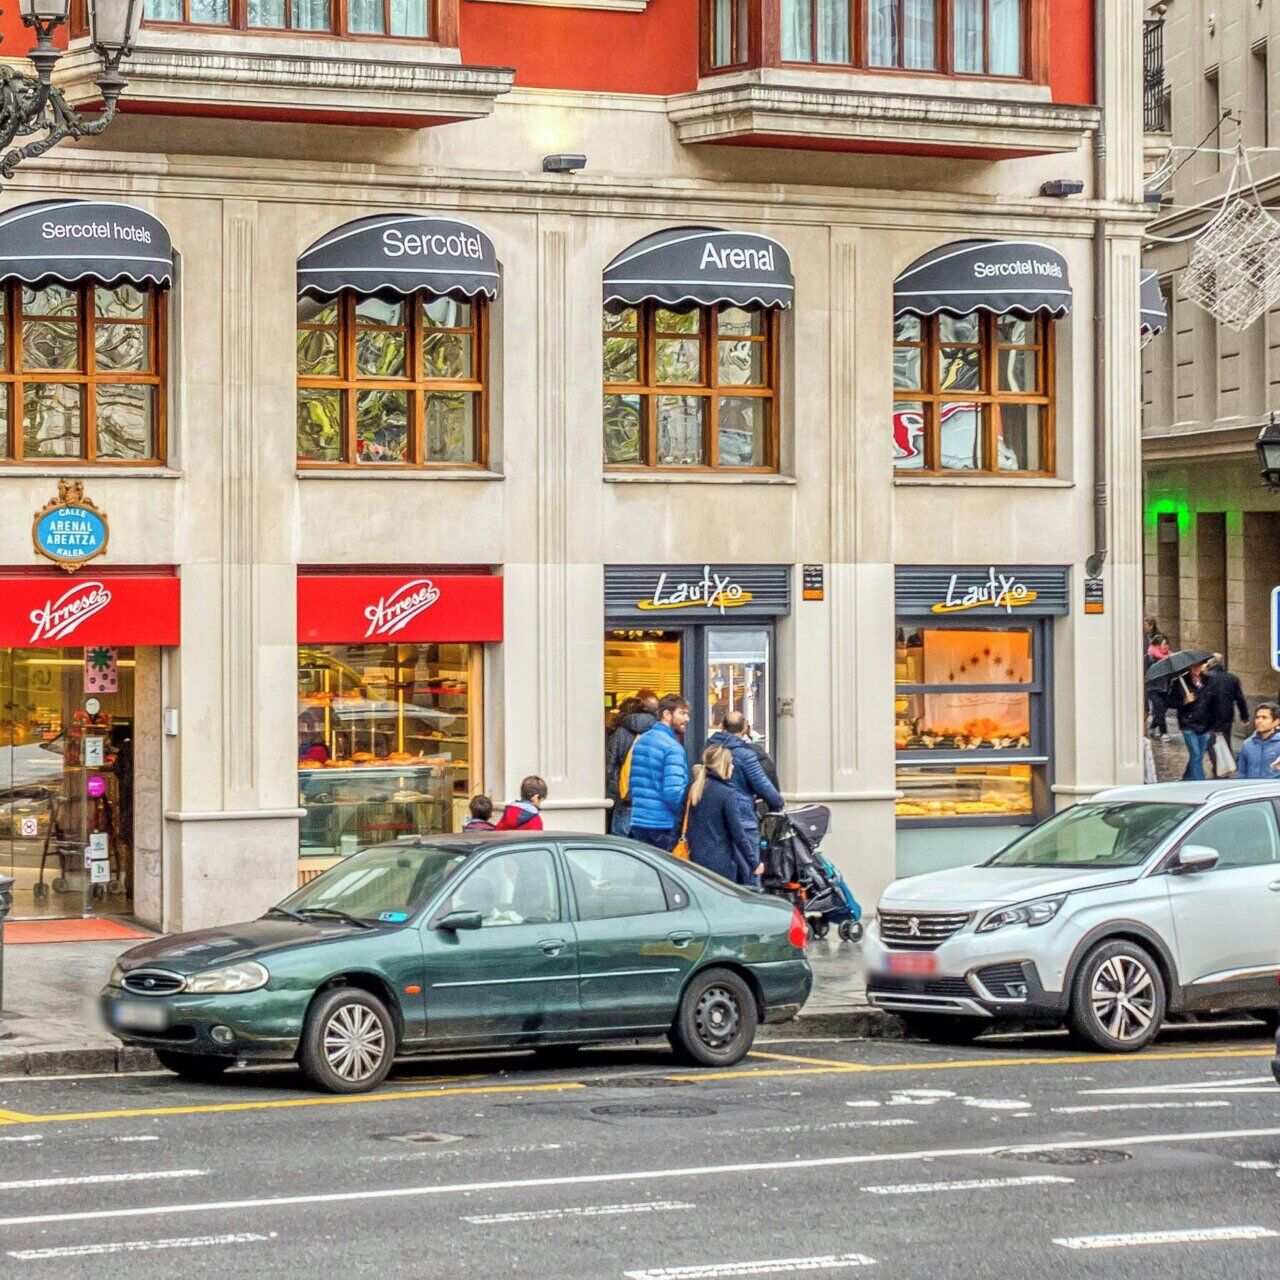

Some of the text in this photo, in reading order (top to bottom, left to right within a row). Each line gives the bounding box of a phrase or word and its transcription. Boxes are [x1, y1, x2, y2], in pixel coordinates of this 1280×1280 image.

[41, 220, 152, 244] Sercotel hotels
[382, 228, 484, 261] Sercotel
[699, 241, 775, 272] Arenal
[973, 259, 1063, 279] Sercotel hotels
[58, 508, 87, 518] CALLE
[49, 521, 93, 532] ARENAL
[46, 534, 96, 545] AREATZA
[56, 547, 85, 557] KALEA
[29, 581, 112, 642] Arrese
[364, 579, 441, 638] Arrese
